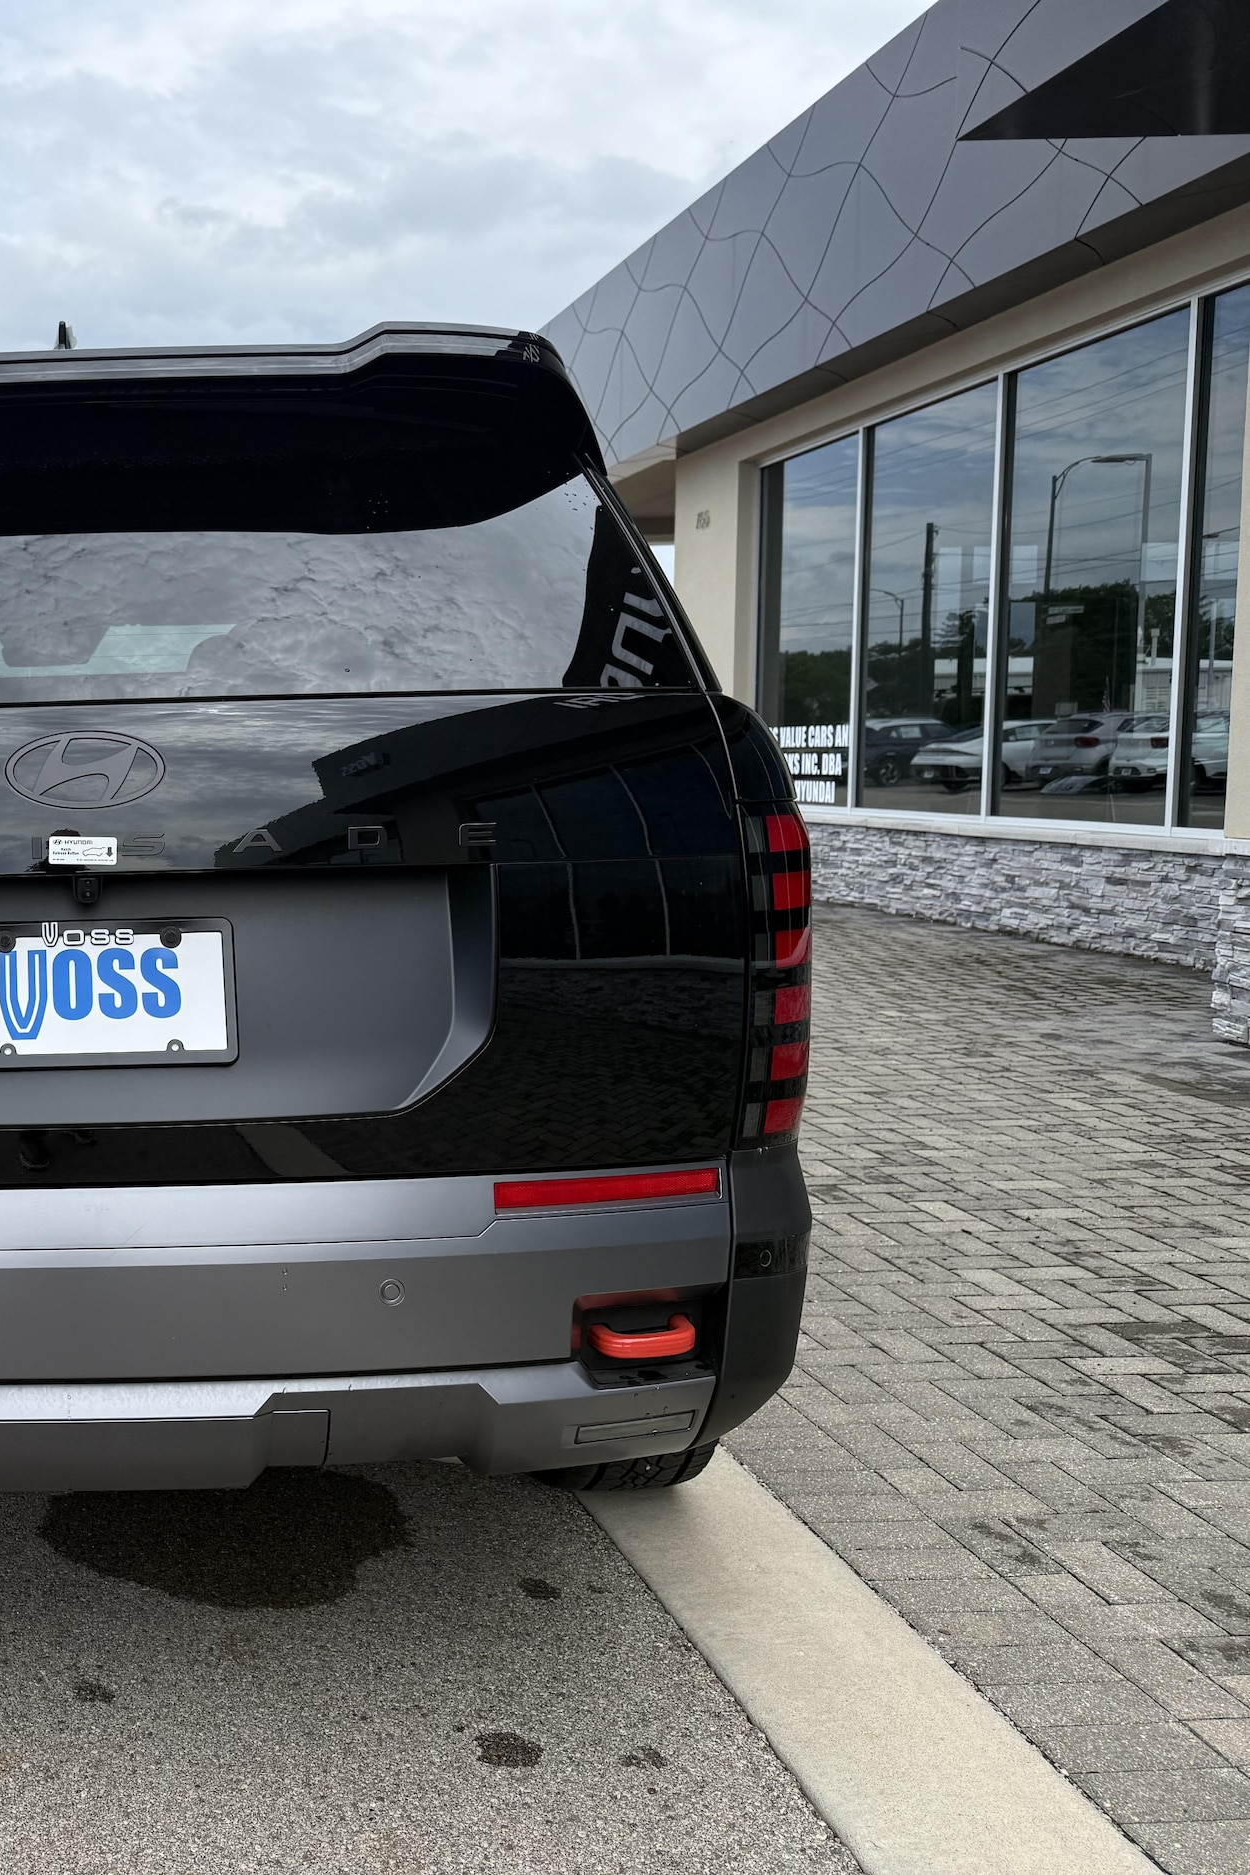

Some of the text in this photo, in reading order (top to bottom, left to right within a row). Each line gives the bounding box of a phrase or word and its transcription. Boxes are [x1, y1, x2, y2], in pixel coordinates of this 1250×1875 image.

[780, 726, 807, 748] VALUE
[808, 724, 834, 748] CARS
[835, 724, 849, 748] AN
[801, 752, 820, 776] INC.
[821, 752, 842, 776] DBA
[794, 780, 836, 803] HYUNDAI
